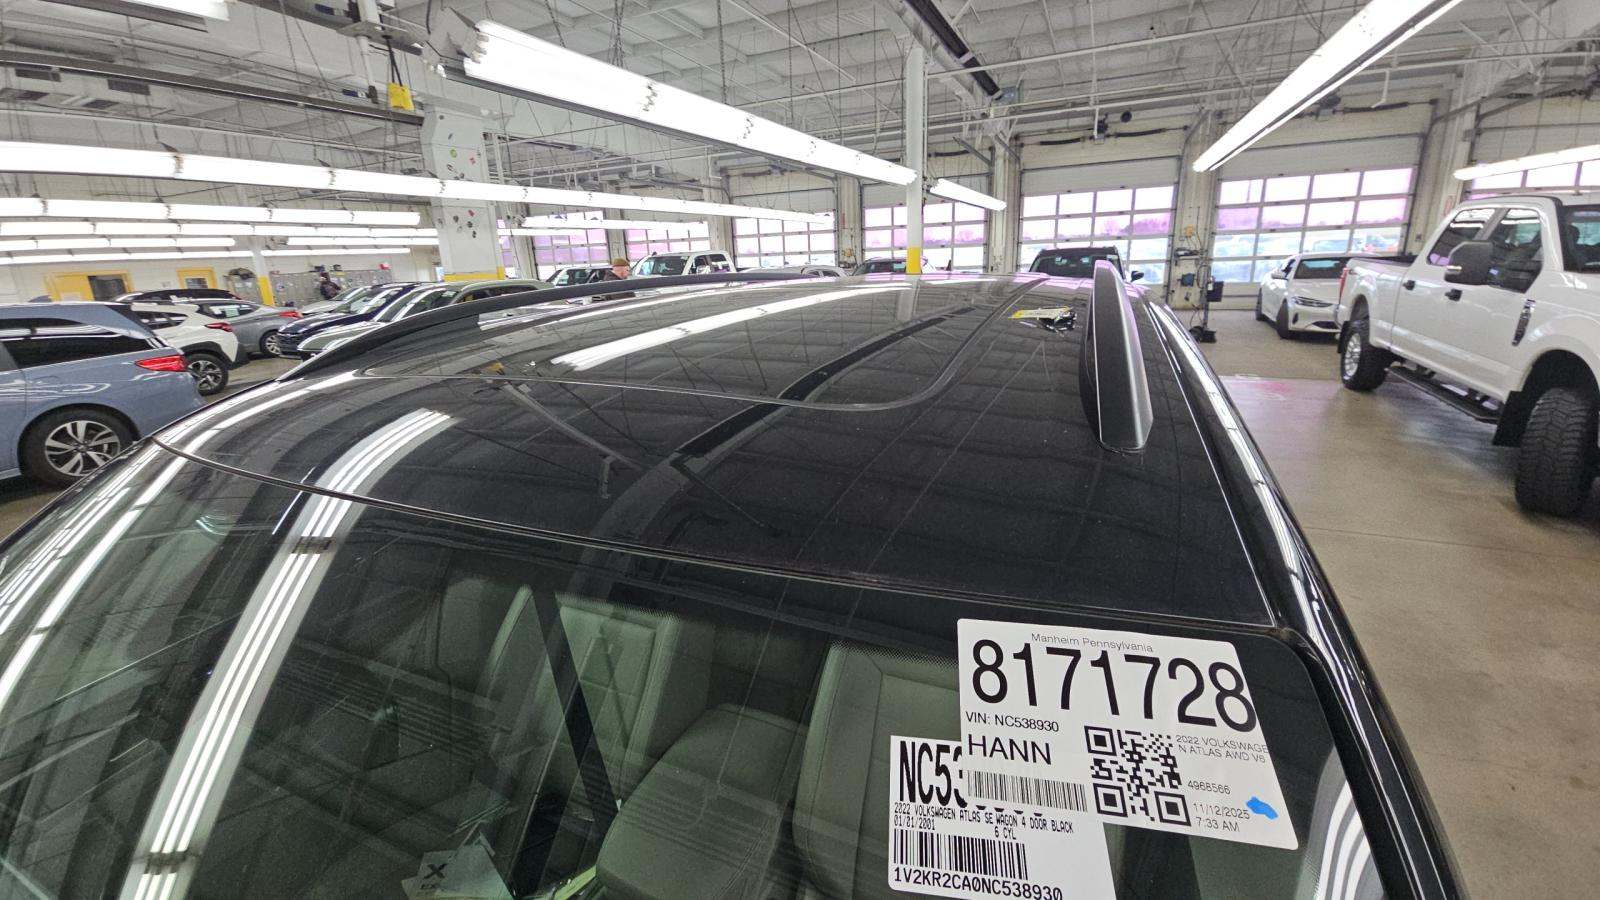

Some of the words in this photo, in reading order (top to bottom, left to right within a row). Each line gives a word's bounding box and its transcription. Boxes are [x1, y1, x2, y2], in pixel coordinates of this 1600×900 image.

[1031, 633, 1080, 646] Manheim
[1082, 637, 1154, 652] Pennsylvania
[972, 639, 1256, 732] 8171728
[965, 711, 991, 725] VIN:
[994, 714, 1059, 732] NC538930
[968, 734, 1052, 765] HANN
[1176, 734, 1200, 745] 2022
[1201, 737, 1270, 754] VOLKSWAGE
[1189, 746, 1222, 758] ATLAS
[1225, 751, 1249, 761] AWD
[894, 802, 911, 815] 2022
[914, 804, 956, 820] VOLKSWAGEN
[959, 809, 981, 823] ATLAS
[984, 812, 994, 825] SE
[995, 813, 1018, 827] WAGON
[1021, 816, 1026, 828] 4
[1029, 817, 1048, 830] DOOR
[1050, 819, 1074, 834] BLACK
[1193, 803, 1250, 819] 11/12/2025
[994, 825, 1000, 838] 6
[1003, 826, 1017, 840] CYL
[1222, 820, 1240, 832] AM
[894, 866, 1063, 900] 1V2KR2CA0NC538930
